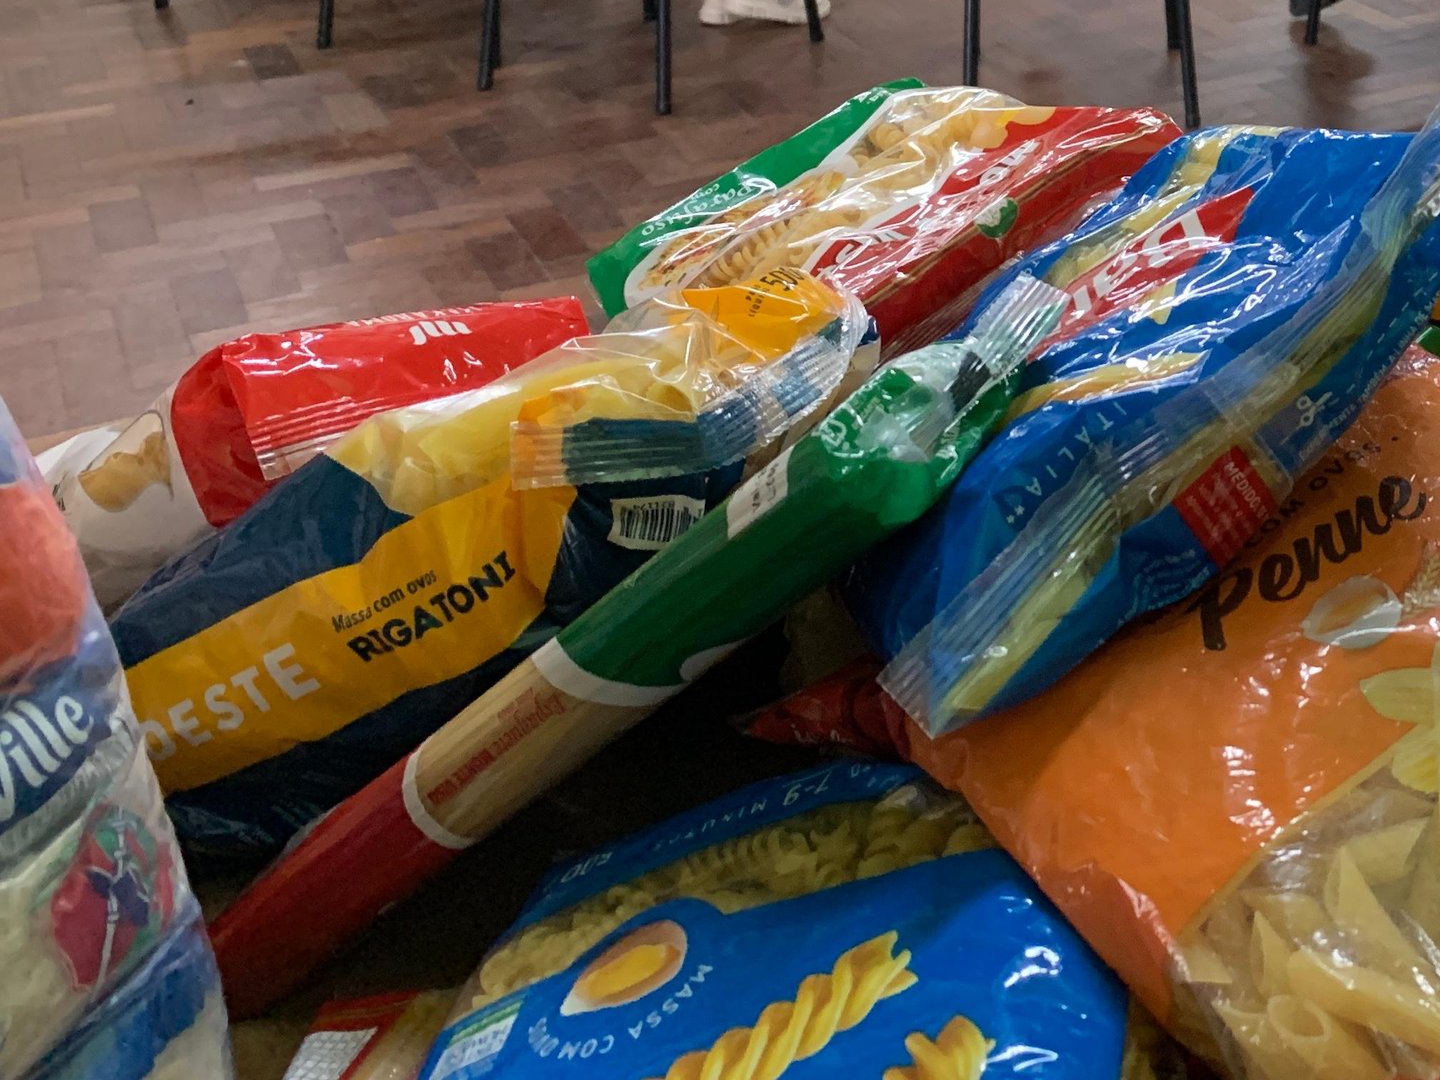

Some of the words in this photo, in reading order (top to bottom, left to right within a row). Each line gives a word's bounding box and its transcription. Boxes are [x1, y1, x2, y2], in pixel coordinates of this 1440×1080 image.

[640, 178, 754, 238] Parafuso
[1308, 442, 1382, 492] OVOS
[1184, 475, 1427, 652] Penne
[331, 606, 374, 634] Massa
[373, 586, 405, 613] com
[406, 569, 438, 595] ovos
[346, 551, 517, 663] RIGATONI
[144, 642, 323, 763] DESTE
[626, 963, 714, 1040] MASSA
[557, 1032, 617, 1061] COM
